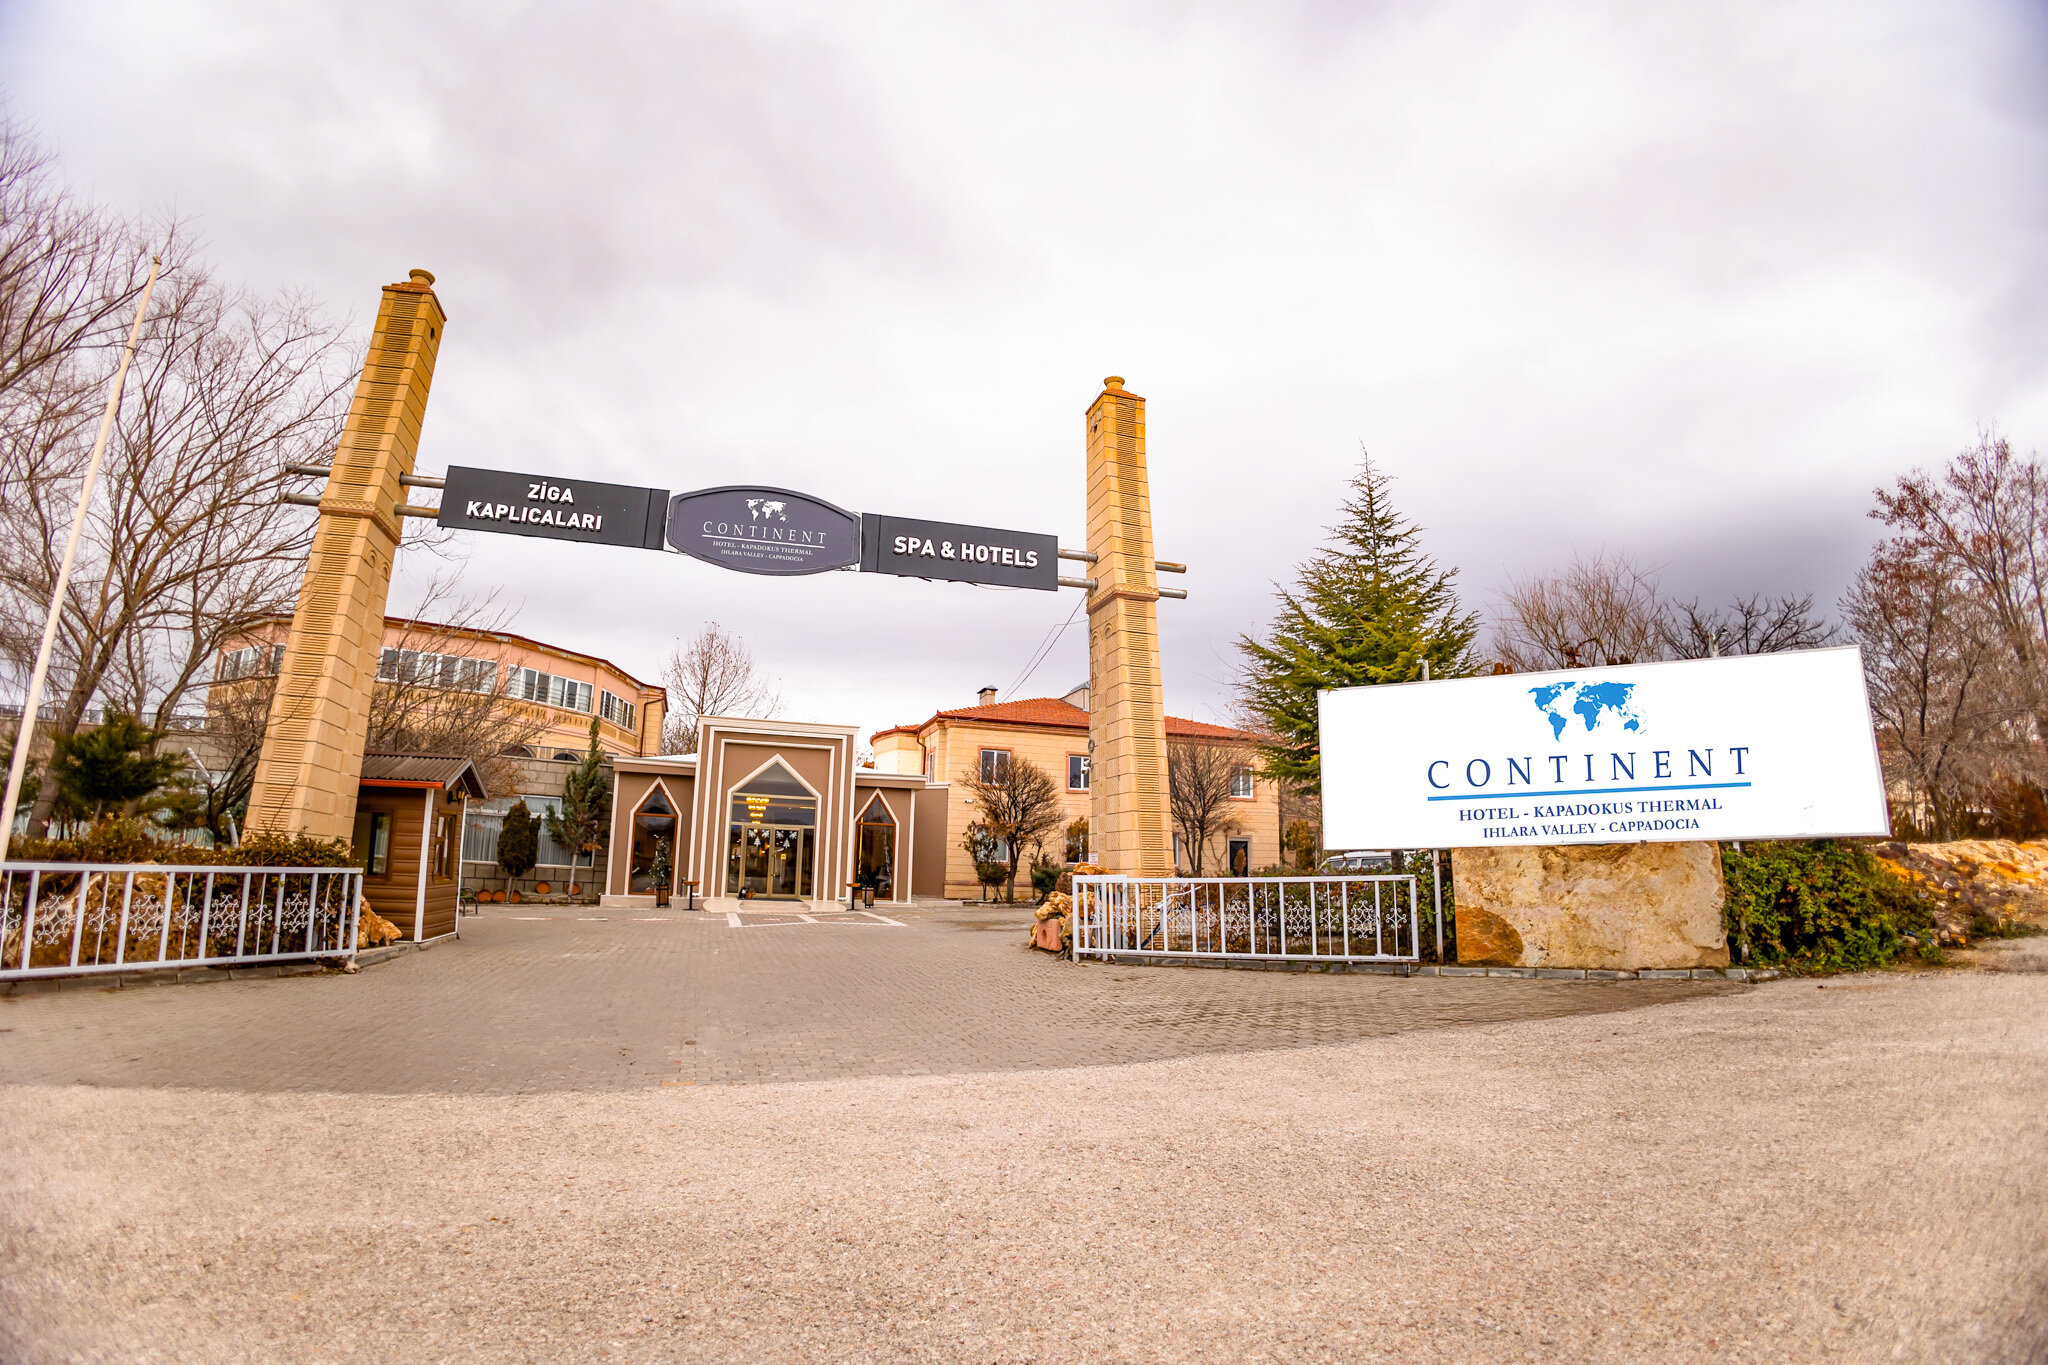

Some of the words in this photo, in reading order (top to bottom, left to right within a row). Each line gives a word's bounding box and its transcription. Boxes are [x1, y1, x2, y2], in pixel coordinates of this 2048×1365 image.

[527, 481, 574, 503] ZİGA
[703, 521, 827, 544] CONTINENT
[713, 540, 736, 549] HOTEL
[741, 543, 780, 553] KAPADOKUS
[781, 547, 813, 556] THERMAL
[769, 554, 804, 562] CAPPADOCIA
[894, 536, 936, 557] SPA
[940, 540, 955, 560] &
[961, 543, 1038, 568] HOTELS
[1427, 747, 1749, 789] CONTINENT
[1459, 808, 1519, 822] HOTEL
[1533, 801, 1633, 818] KAPADOKUS
[1637, 798, 1723, 814] THERMAL
[1483, 826, 1538, 838] IHLARA
[1541, 822, 1597, 835] VALLEY
[1609, 819, 1700, 833] CAPPADOCIA
